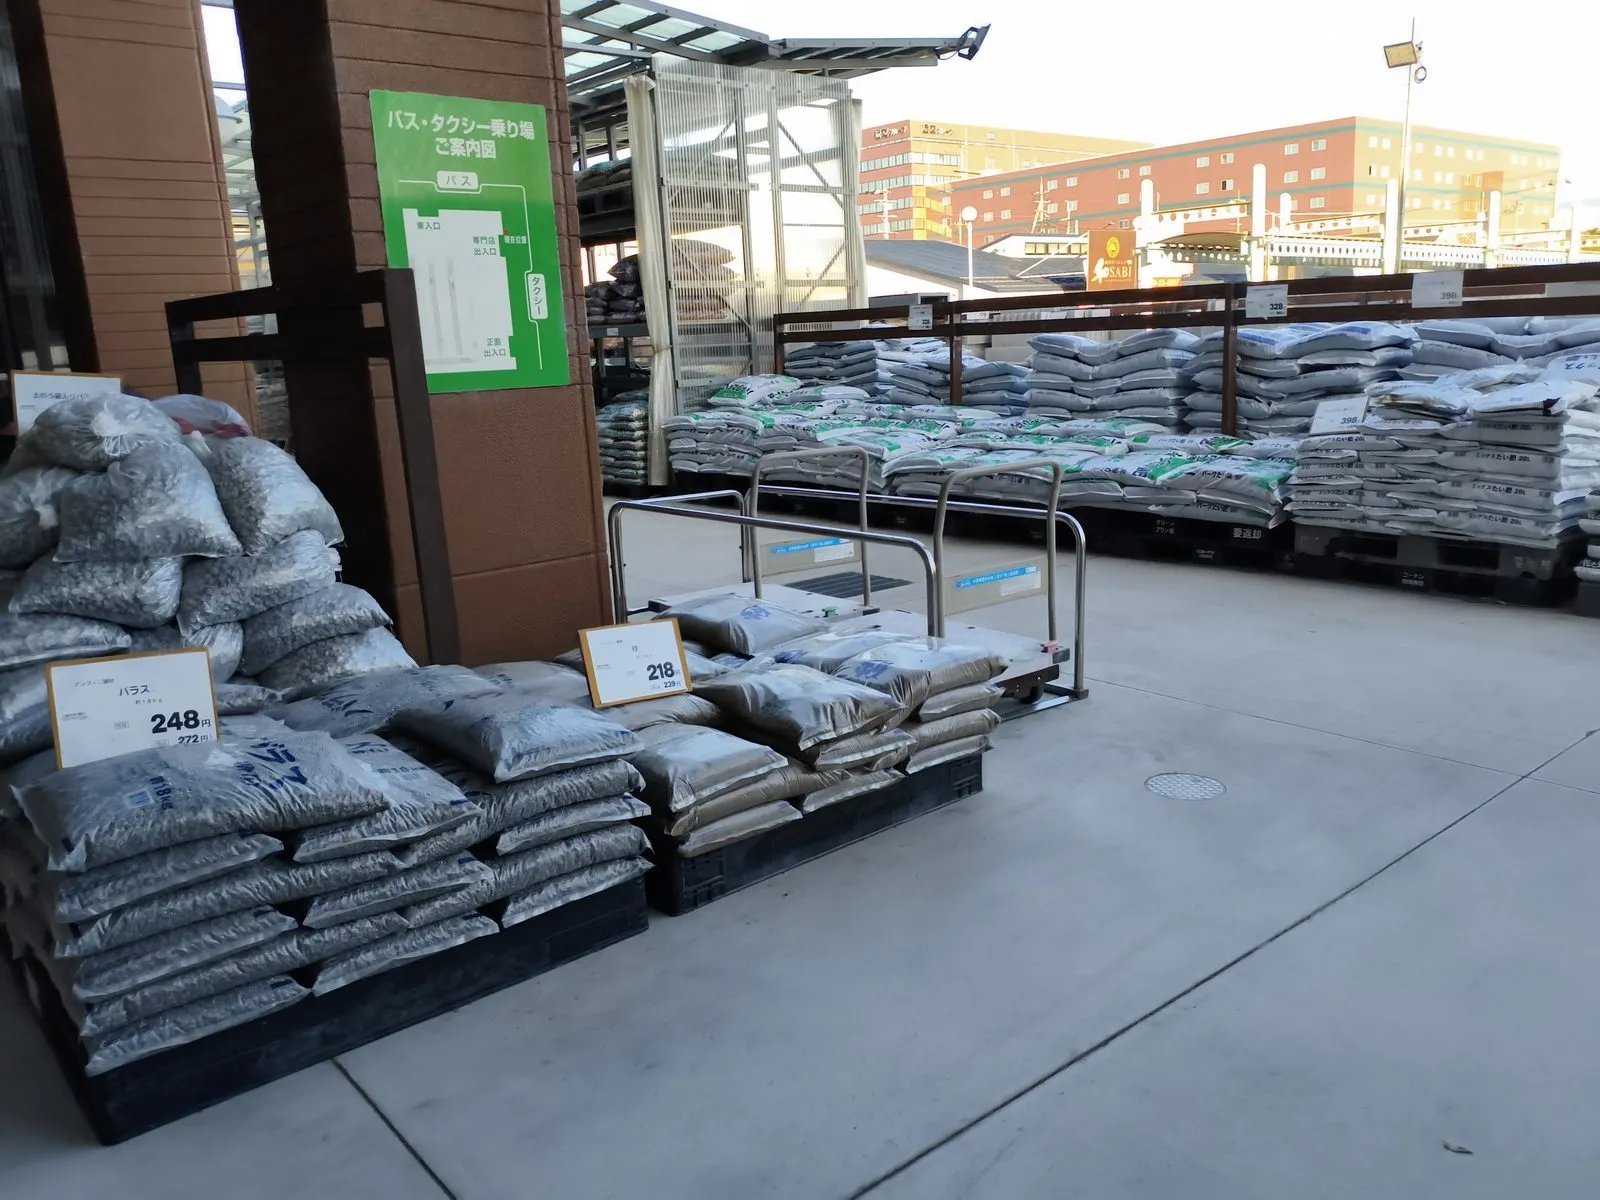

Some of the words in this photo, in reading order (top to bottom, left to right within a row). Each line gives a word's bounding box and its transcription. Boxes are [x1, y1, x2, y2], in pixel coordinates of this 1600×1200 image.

[388, 110, 535, 140] バス・タクシー乗り場
[435, 138, 496, 159] ご案内図
[446, 175, 471, 186] バス
[416, 221, 441, 230] 東入口
[472, 236, 496, 244] 専門店
[473, 247, 497, 255] 出入口
[532, 276, 543, 315] タクシー
[487, 337, 502, 346] 正面
[483, 349, 506, 357] 出入口
[1340, 416, 1358, 424] 398
[1233, 527, 1262, 539] 要返却
